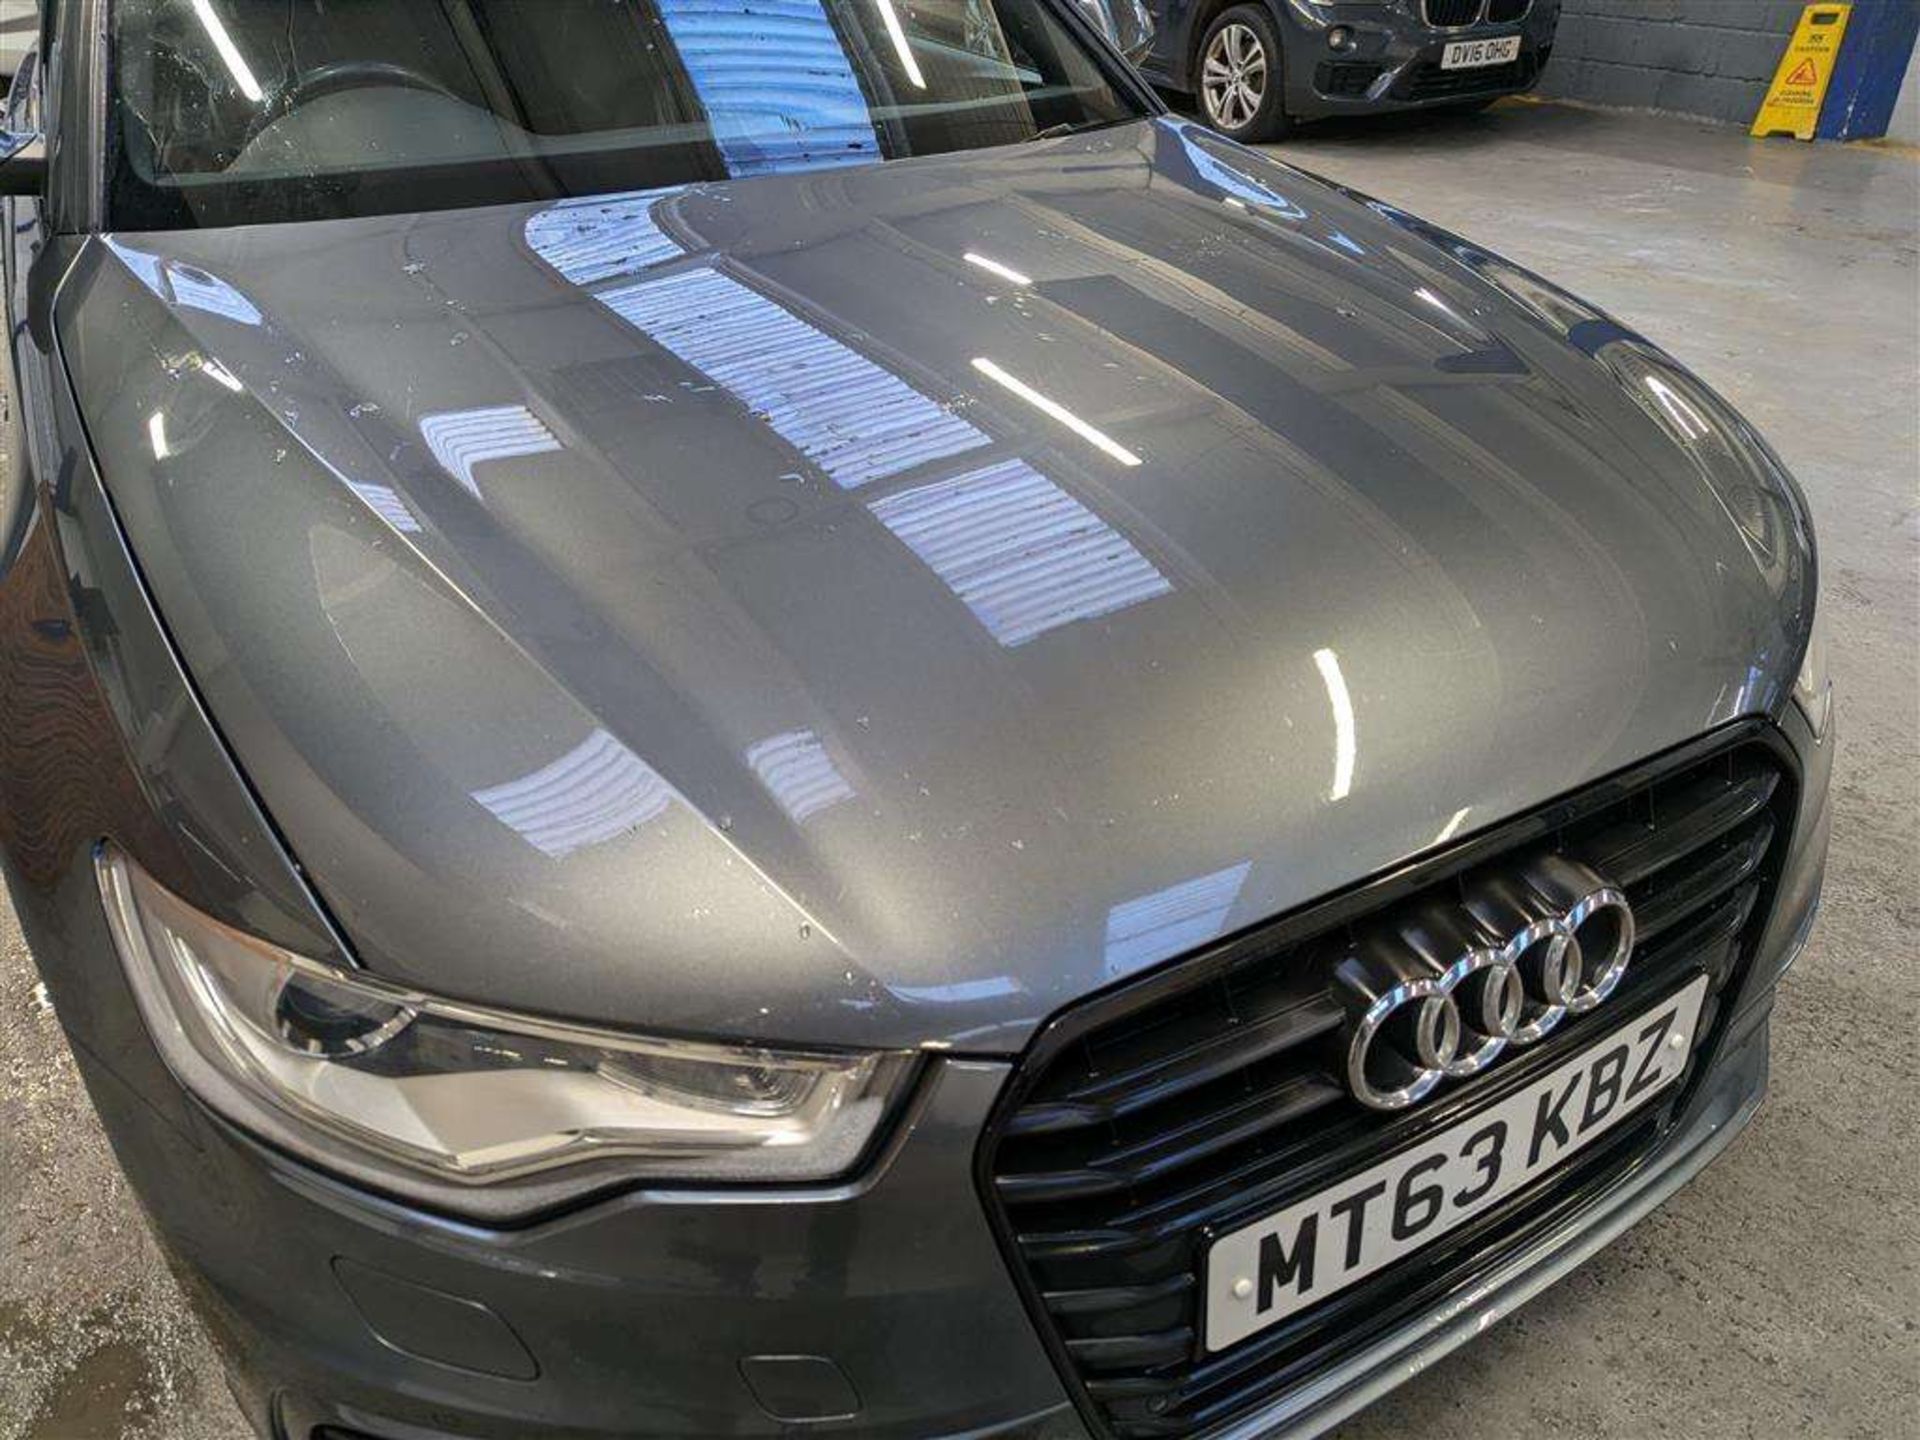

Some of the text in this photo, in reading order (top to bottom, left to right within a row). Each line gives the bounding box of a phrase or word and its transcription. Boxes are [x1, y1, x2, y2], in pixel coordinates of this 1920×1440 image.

[1450, 43, 1483, 64] DV16
[1256, 1007, 1679, 1315] MT63 KBZ
